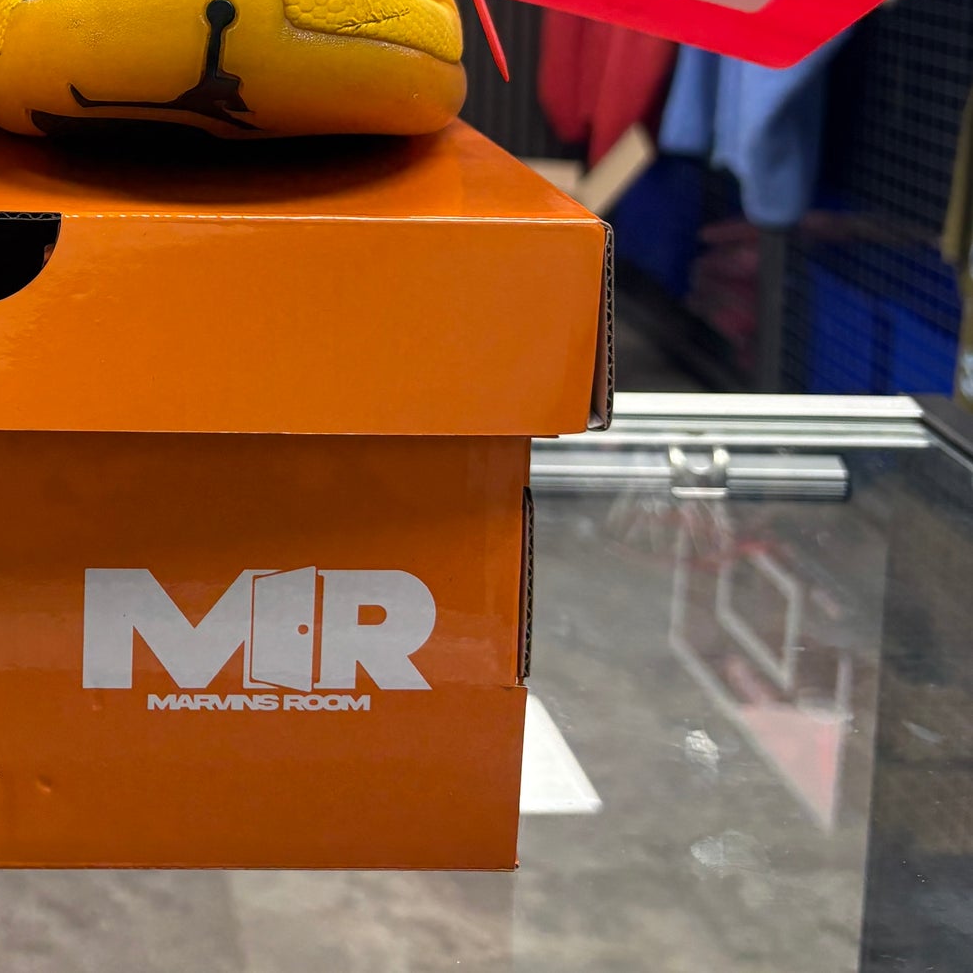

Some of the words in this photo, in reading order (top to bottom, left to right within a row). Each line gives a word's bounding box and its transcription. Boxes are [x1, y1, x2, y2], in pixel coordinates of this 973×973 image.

[82, 566, 436, 691] MR
[147, 694, 279, 711] MARVINS
[283, 694, 370, 711] ROOM
